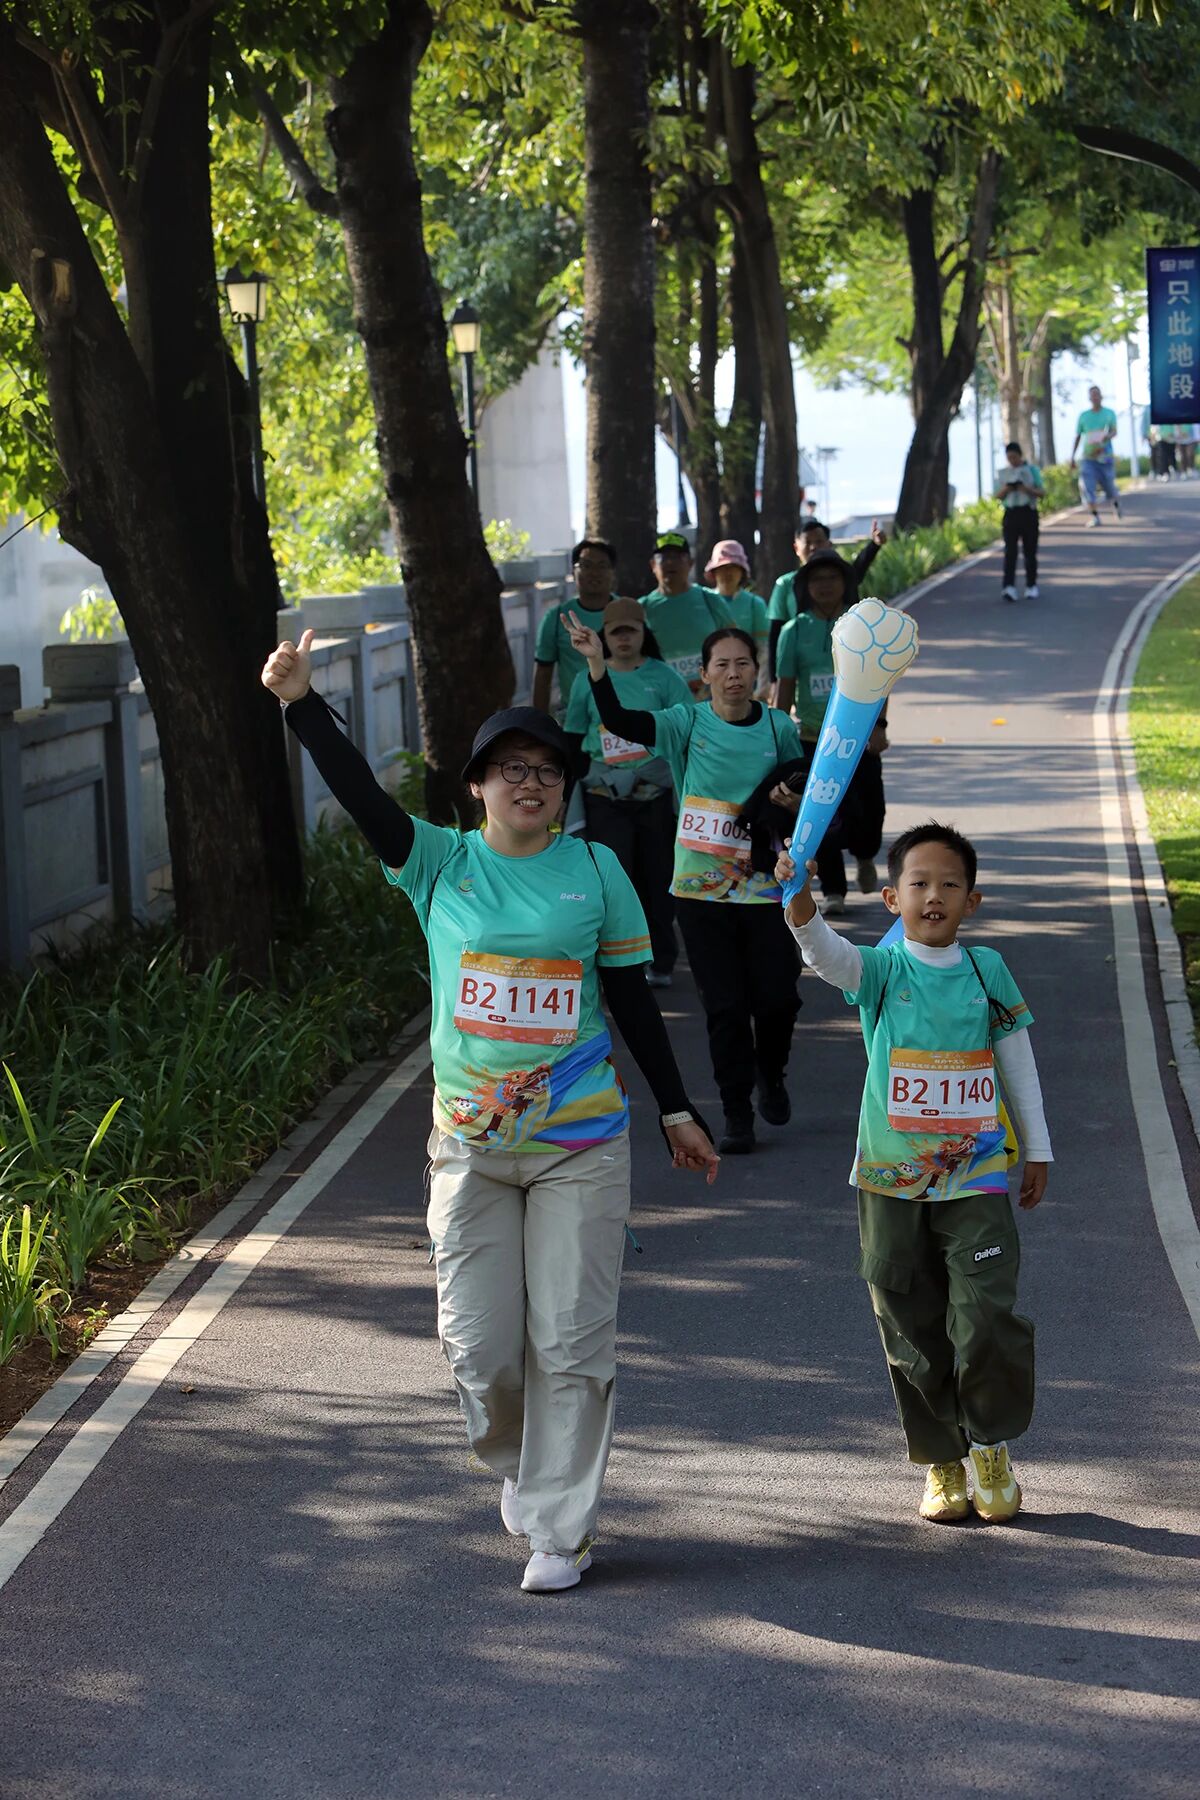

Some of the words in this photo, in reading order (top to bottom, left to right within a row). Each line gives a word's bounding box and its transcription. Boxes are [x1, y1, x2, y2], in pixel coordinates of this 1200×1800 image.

[1167, 280, 1195, 399] 只此地段
[682, 813, 706, 833] B2
[460, 977, 497, 1010] B2
[508, 985, 575, 1015] 1141
[892, 1076, 929, 1105] B2
[939, 1076, 995, 1105] 1140
